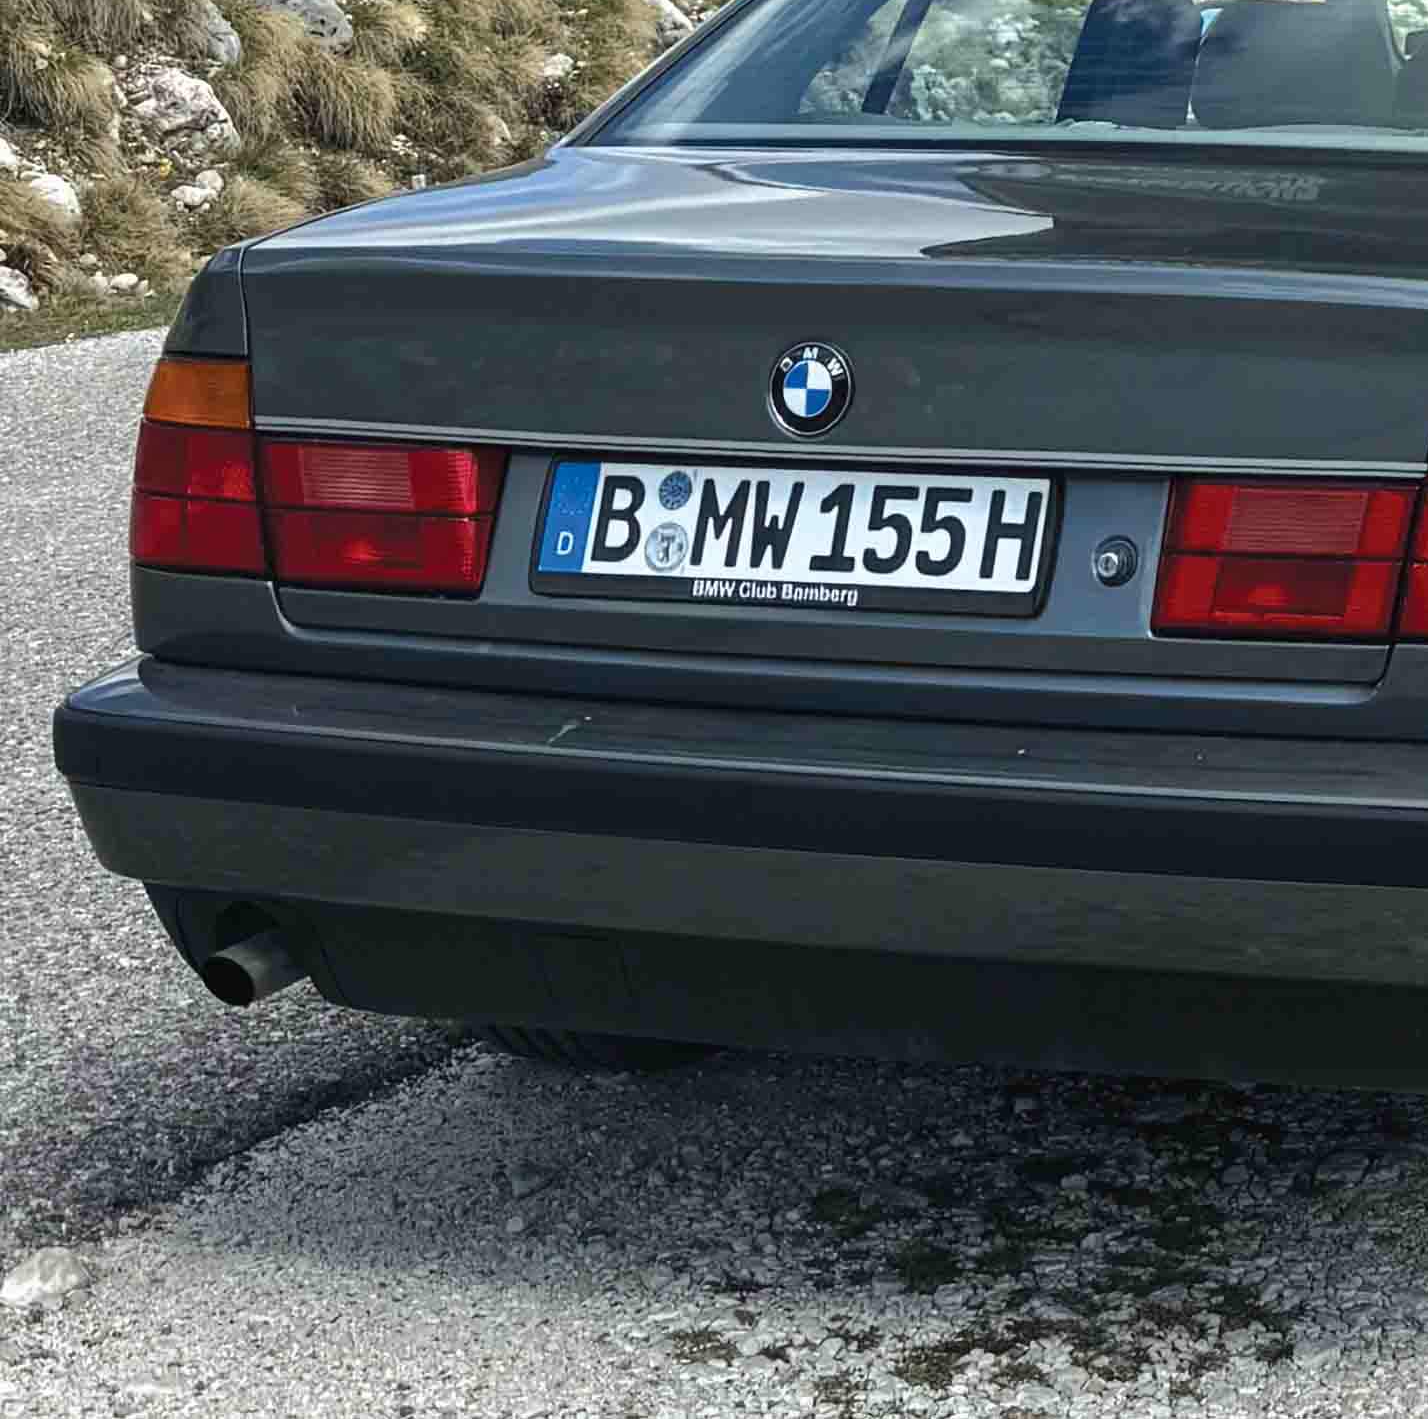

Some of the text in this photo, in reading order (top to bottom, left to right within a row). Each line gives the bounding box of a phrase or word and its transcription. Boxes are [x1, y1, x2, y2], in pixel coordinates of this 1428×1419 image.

[557, 531, 574, 555] D
[692, 579, 736, 598] BMW
[738, 581, 777, 599] Club
